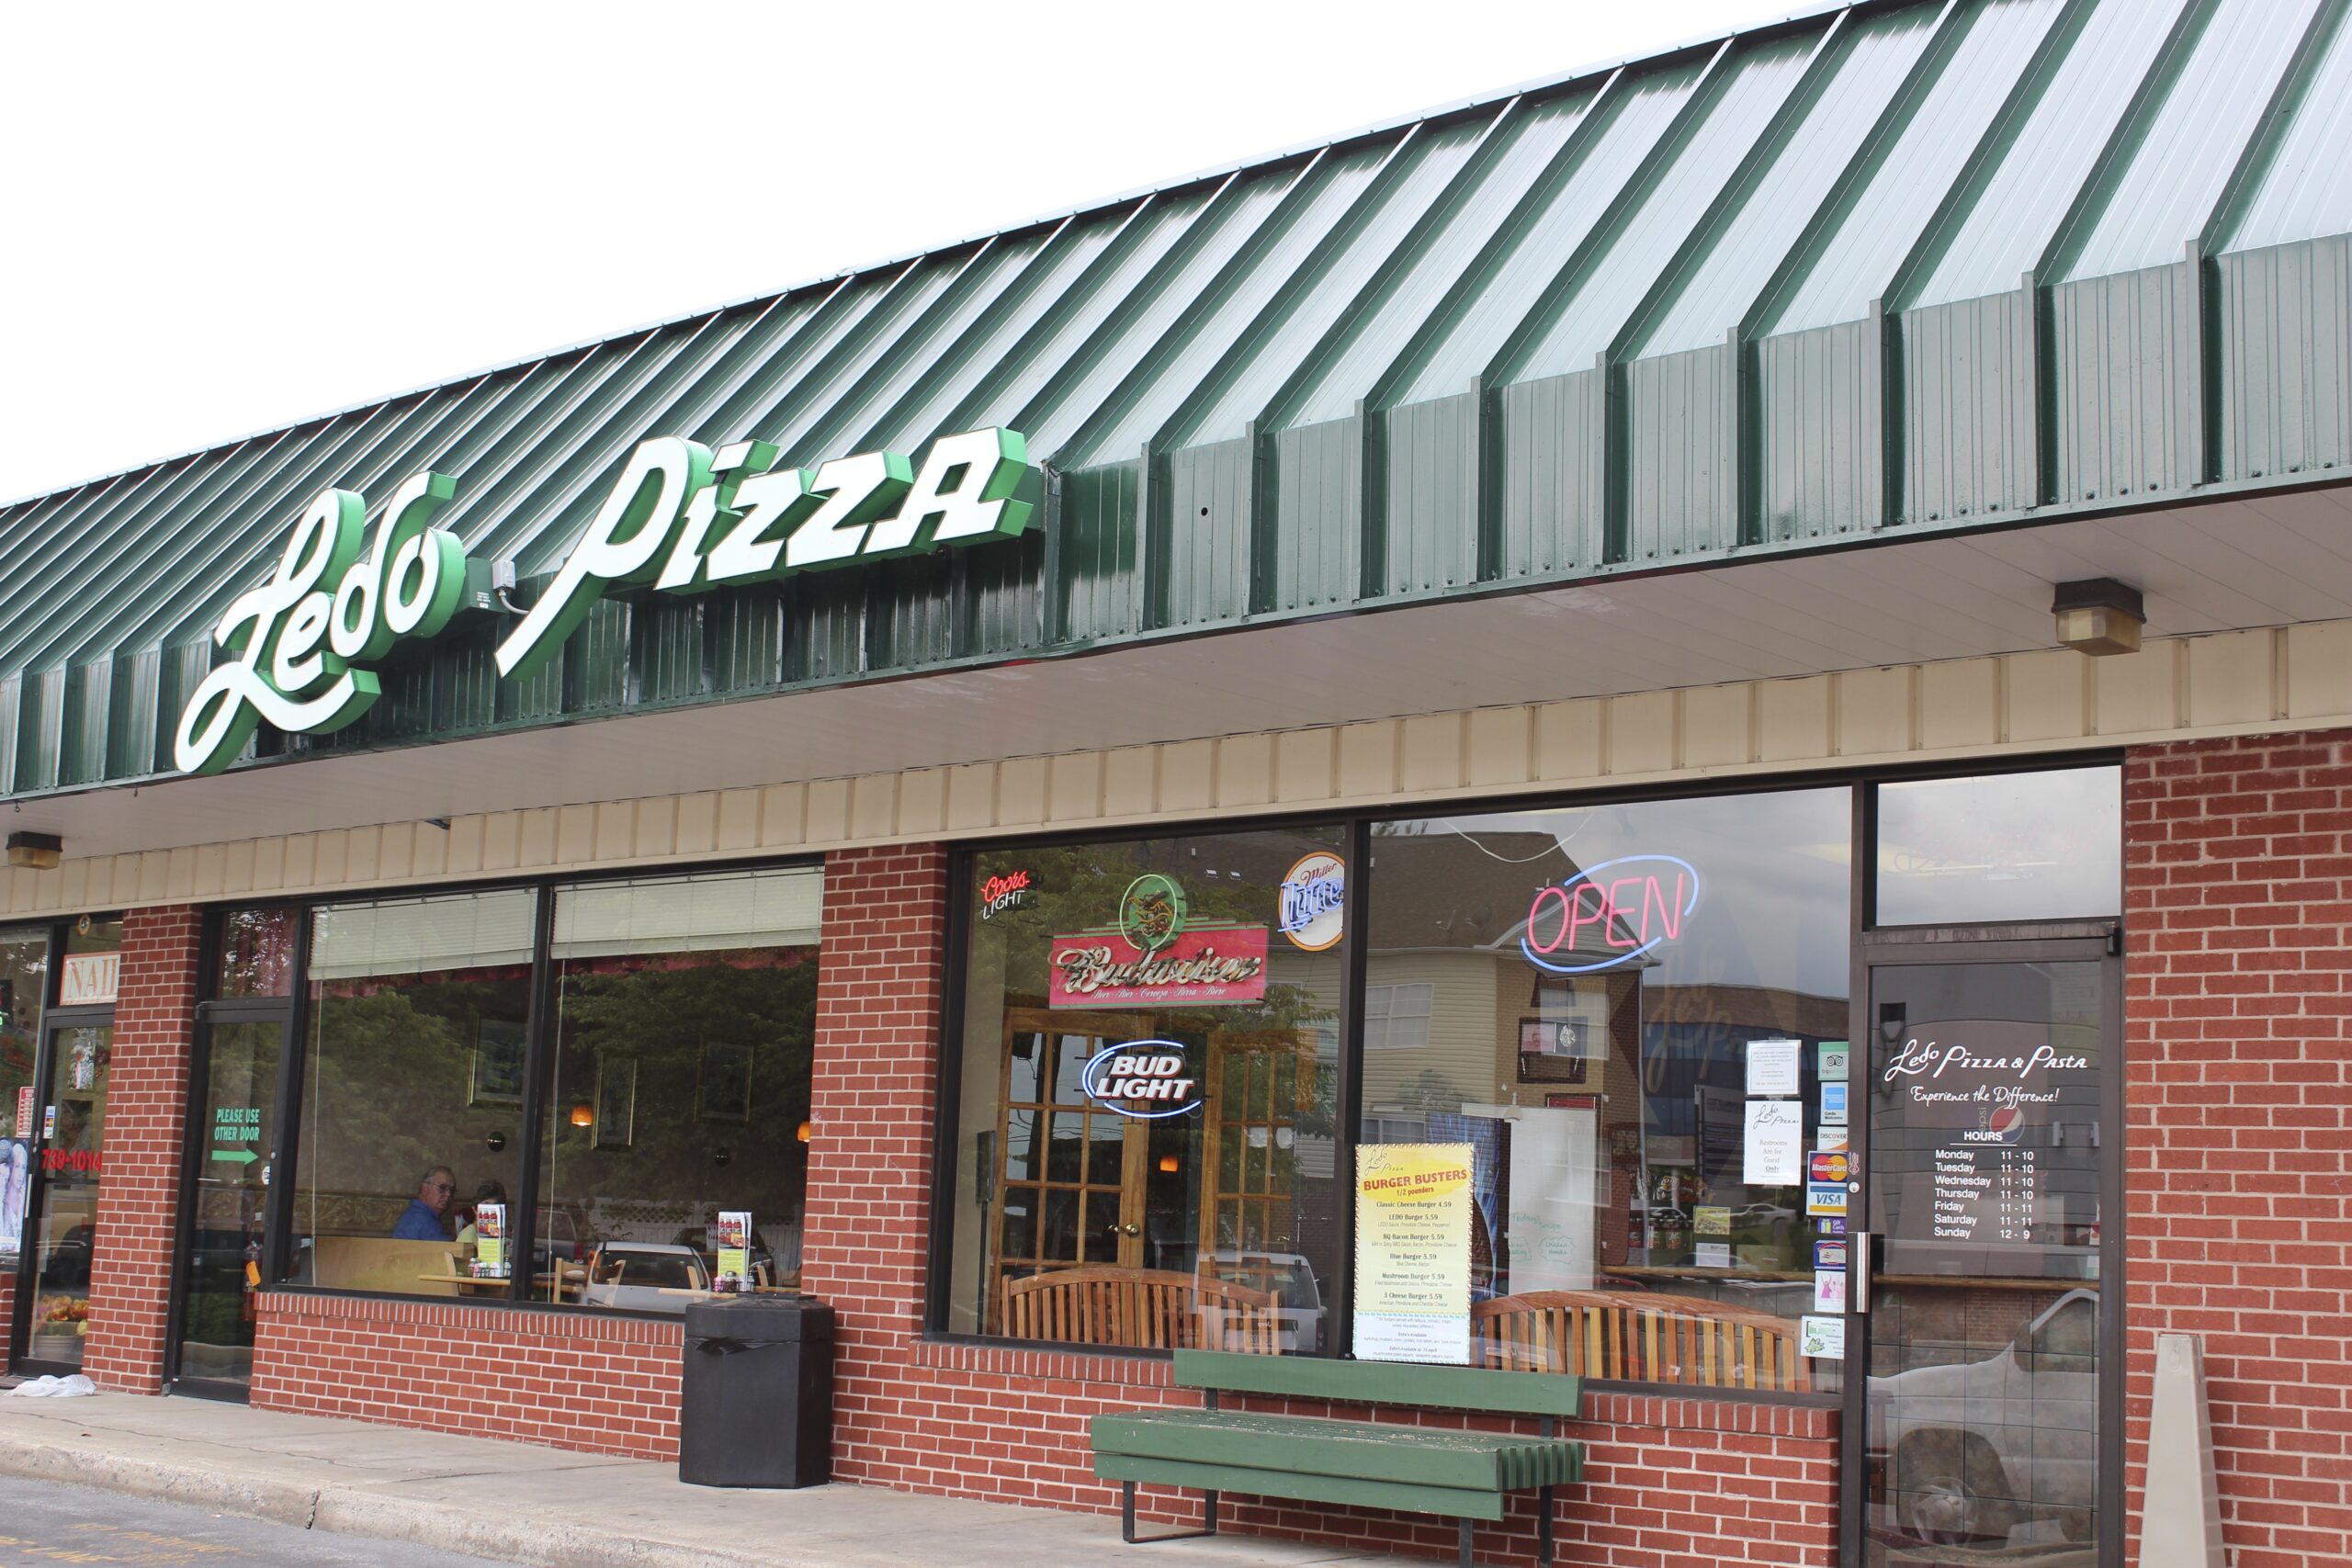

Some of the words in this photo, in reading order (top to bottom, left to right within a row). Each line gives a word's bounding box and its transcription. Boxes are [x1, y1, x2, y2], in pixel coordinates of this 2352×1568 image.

[175, 470, 459, 777] Ledo
[1300, 863, 1338, 887] Miller
[980, 871, 1030, 902] Coors
[983, 890, 1025, 919] LIGHT
[1278, 877, 1342, 932] Lite
[1527, 873, 1684, 954] OPEN
[1054, 946, 1261, 994] Budweiser
[1110, 1055, 1182, 1077] BUD
[1884, 1039, 1939, 1081] Ledo
[2011, 1057, 2024, 1068] &
[1095, 1077, 1195, 1100] LIGHT
[1910, 1086, 1969, 1107] Experience
[1973, 1084, 1990, 1101] the
[1993, 1086, 2060, 1110] Difference!
[216, 1109, 243, 1122] PLEASE
[245, 1109, 260, 1122] USE
[1753, 1104, 1779, 1130] Ledo
[214, 1126, 237, 1141] OTHER
[239, 1126, 260, 1141] DOOR
[1963, 1131, 2003, 1141] HOURS
[1364, 1148, 1387, 1176] Ledo
[1935, 1149, 1974, 1162] Monday
[2000, 1151, 2011, 1160] 11
[2021, 1151, 2034, 1161] 10
[1812, 1163, 1847, 1172] MasterCard
[1935, 1162, 1975, 1175] Tuesday
[2000, 1164, 2011, 1173] 11
[2021, 1165, 2034, 1174] 10
[1363, 1176, 1411, 1190] BURGER
[1415, 1169, 1467, 1185] BUSTERS
[1935, 1175, 1992, 1188] Wednesday
[2000, 1177, 2011, 1186] 11
[2021, 1178, 2034, 1187] 10
[1408, 1187, 1434, 1197] pounders
[1816, 1194, 1841, 1204] VISA
[1935, 1188, 1980, 1201] Thursday
[2000, 1190, 2011, 1200] 11
[2021, 1190, 2034, 1200] 10
[1935, 1201, 1964, 1213] Friday
[2000, 1203, 2011, 1213] 11
[2021, 1203, 2032, 1213] 11
[1934, 1213, 1977, 1226] Saturday
[2000, 1216, 2011, 1225] 11
[2021, 1217, 2032, 1226] 11
[1934, 1226, 1972, 1239] Sunday
[2000, 1229, 2012, 1239] 12
[2023, 1230, 2030, 1239] 9
